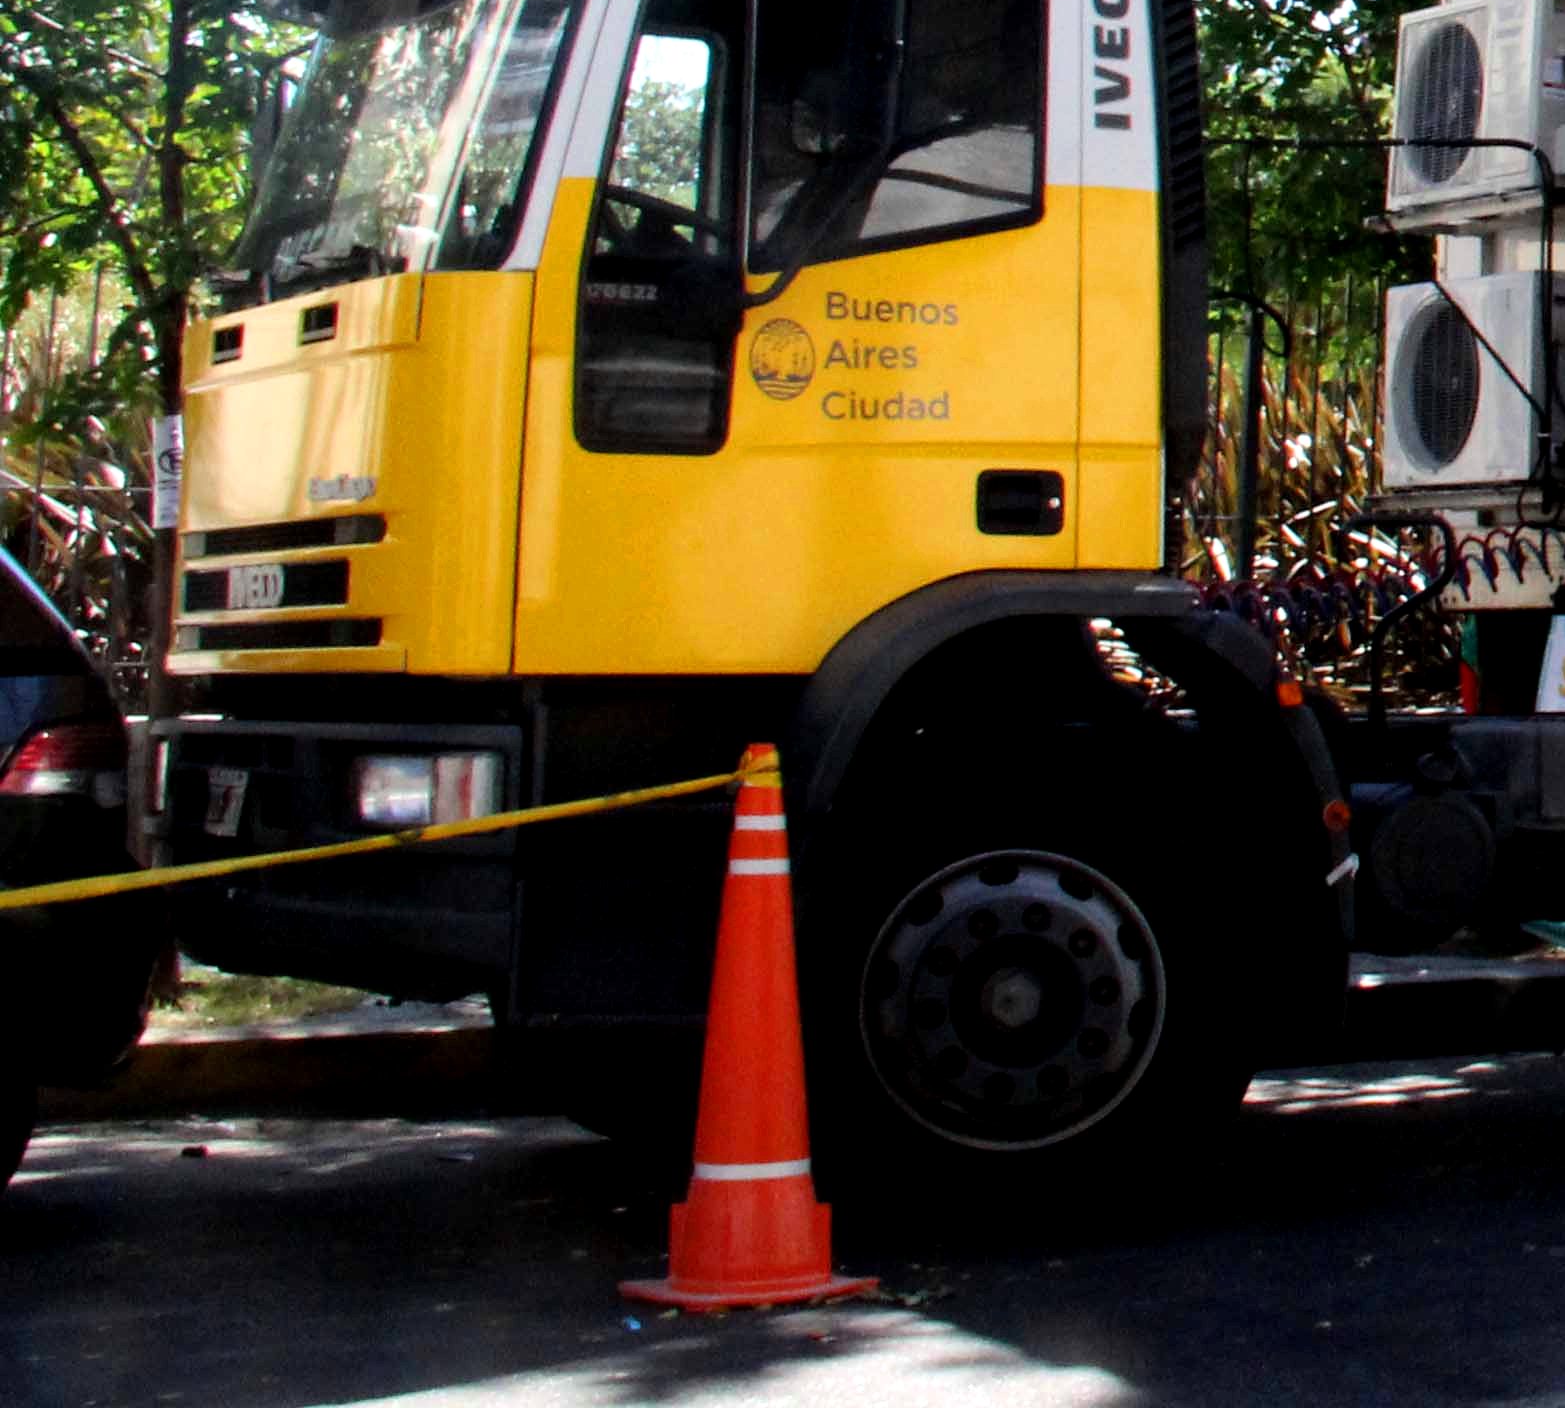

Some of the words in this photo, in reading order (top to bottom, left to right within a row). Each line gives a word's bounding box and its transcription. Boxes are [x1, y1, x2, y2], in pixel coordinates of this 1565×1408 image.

[826, 291, 959, 325] Buenos
[823, 338, 919, 369] Aires
[822, 390, 951, 420] Ciudad
